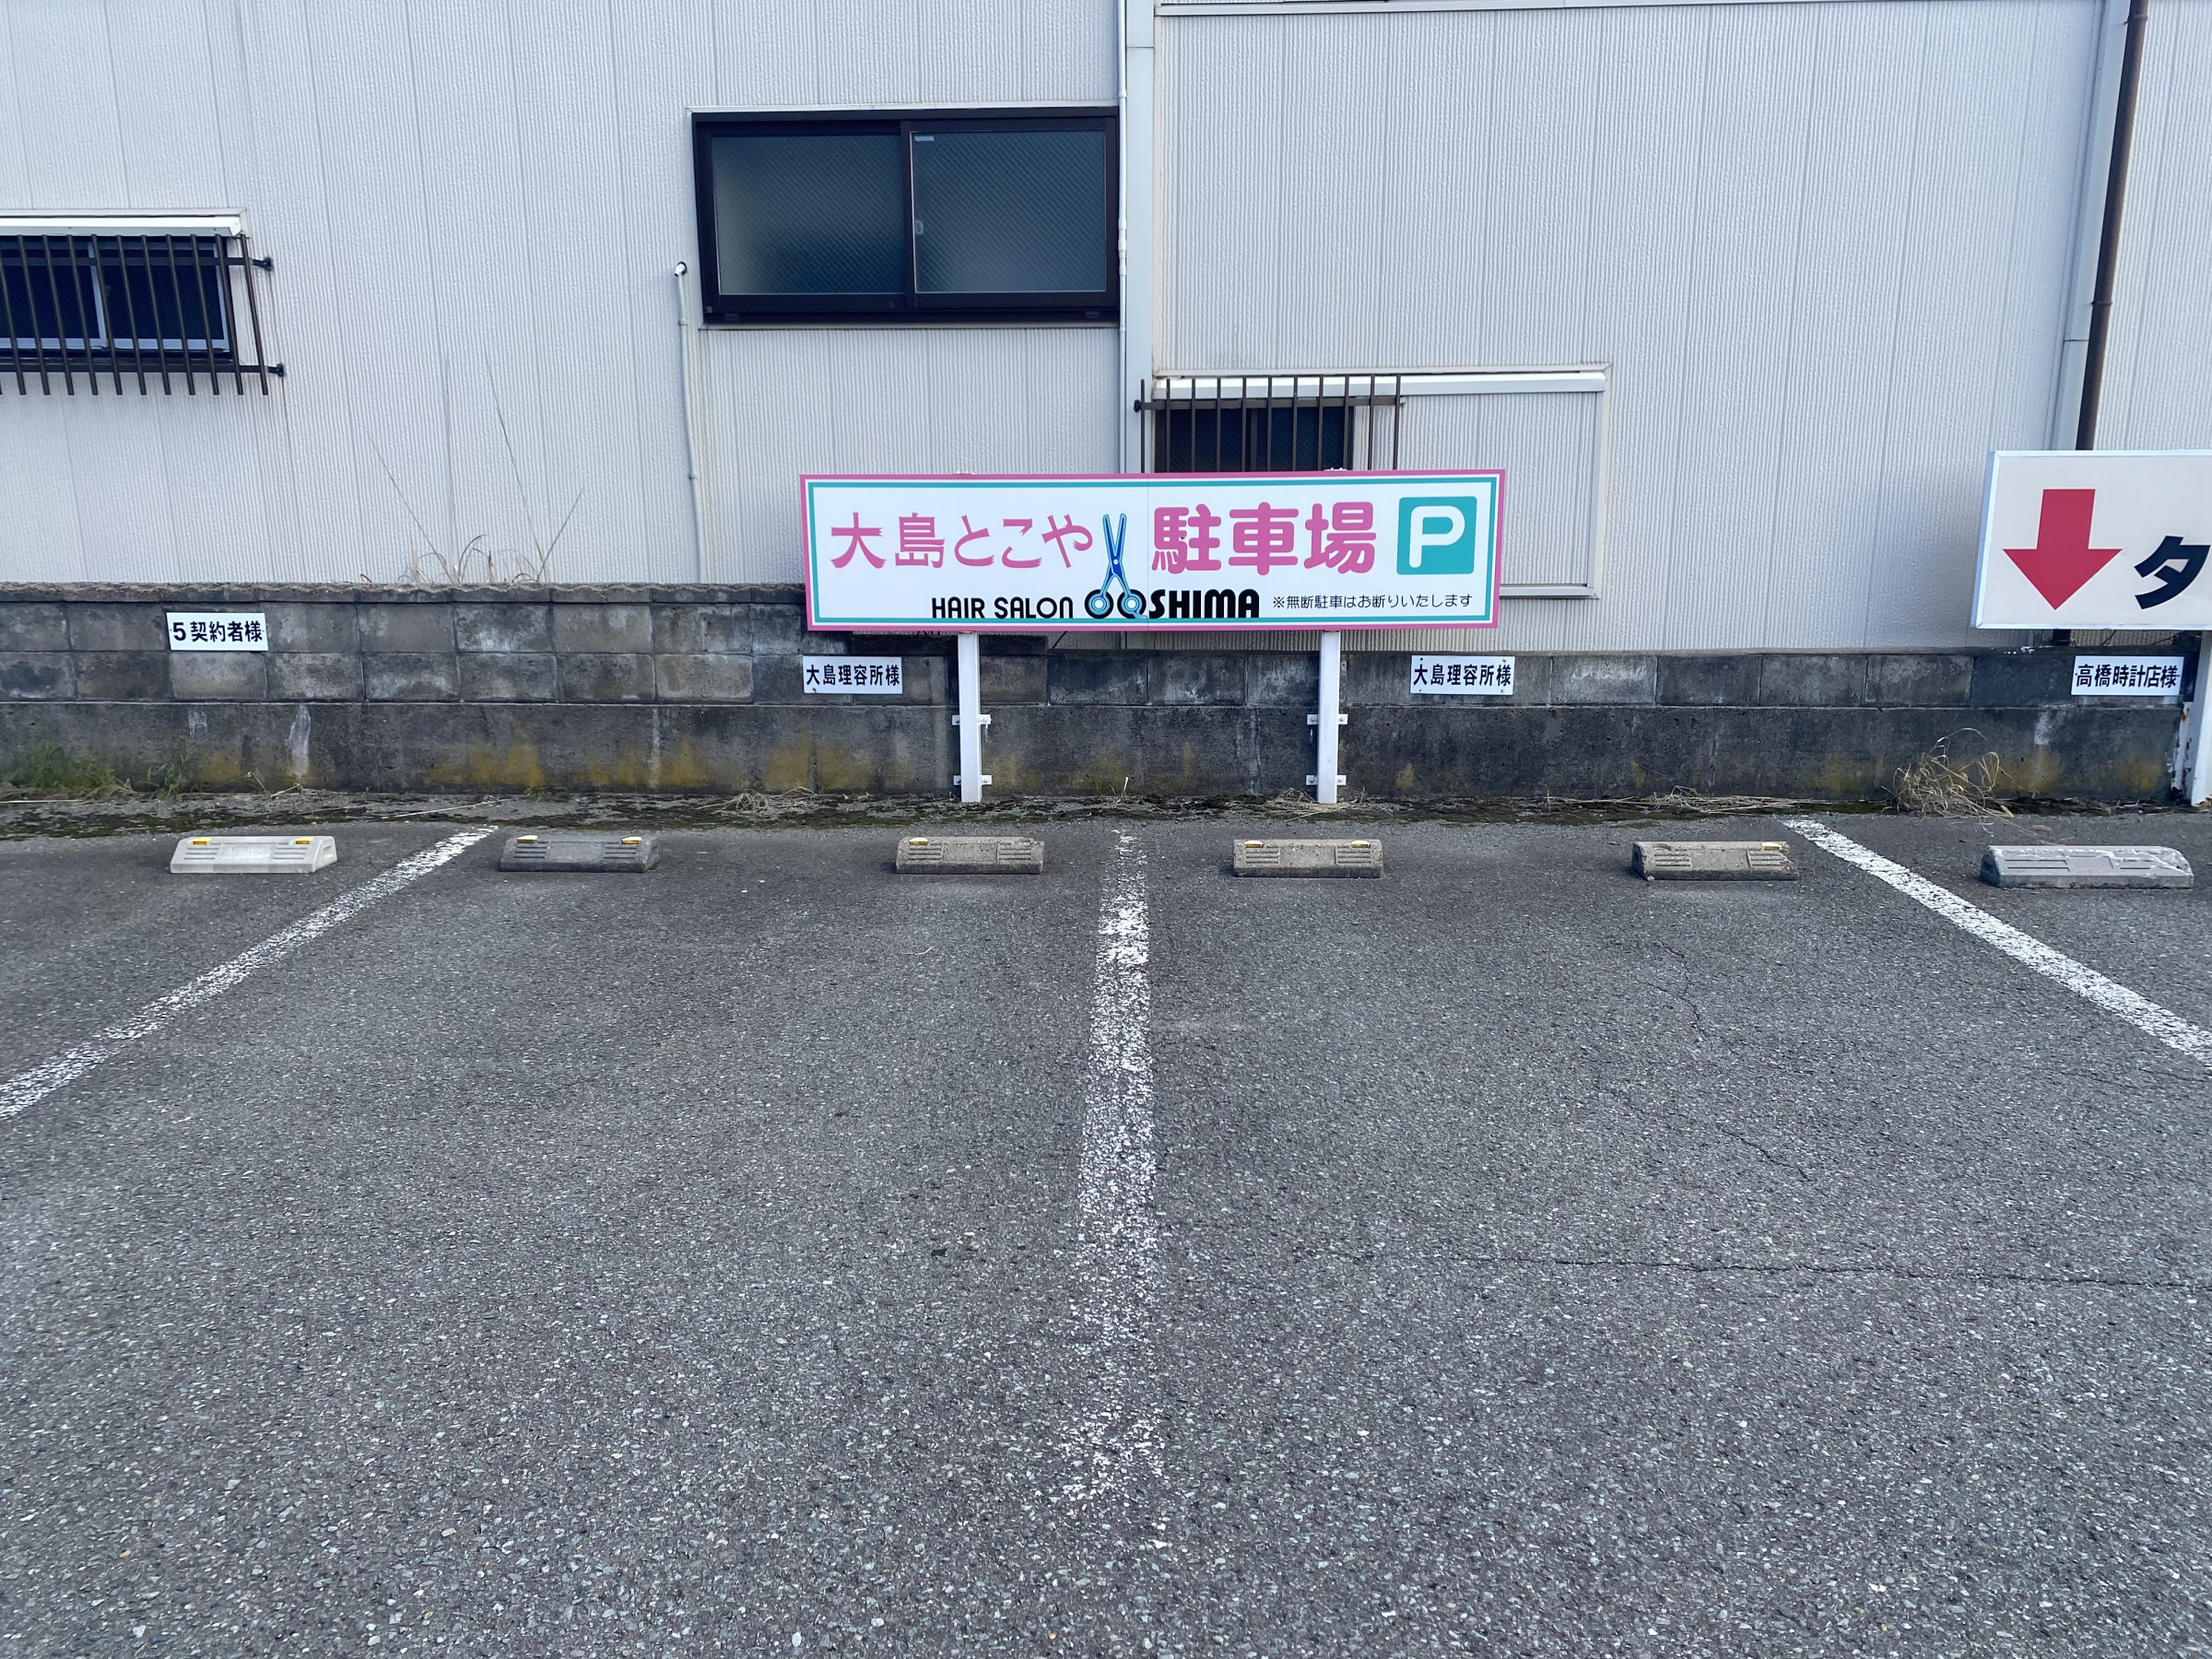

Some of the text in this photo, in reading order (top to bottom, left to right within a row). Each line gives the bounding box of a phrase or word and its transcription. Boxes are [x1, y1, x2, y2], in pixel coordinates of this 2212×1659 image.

[830, 501, 1465, 575] 大島とこや 駐車場 P
[2134, 535, 2211, 610] タ
[931, 588, 1260, 619] HAIR SALON OOSHIMA
[806, 664, 900, 687] 大島理容所様
[1413, 664, 1512, 687] 大島理容所様
[2076, 664, 2179, 688] 高橋時計店様
